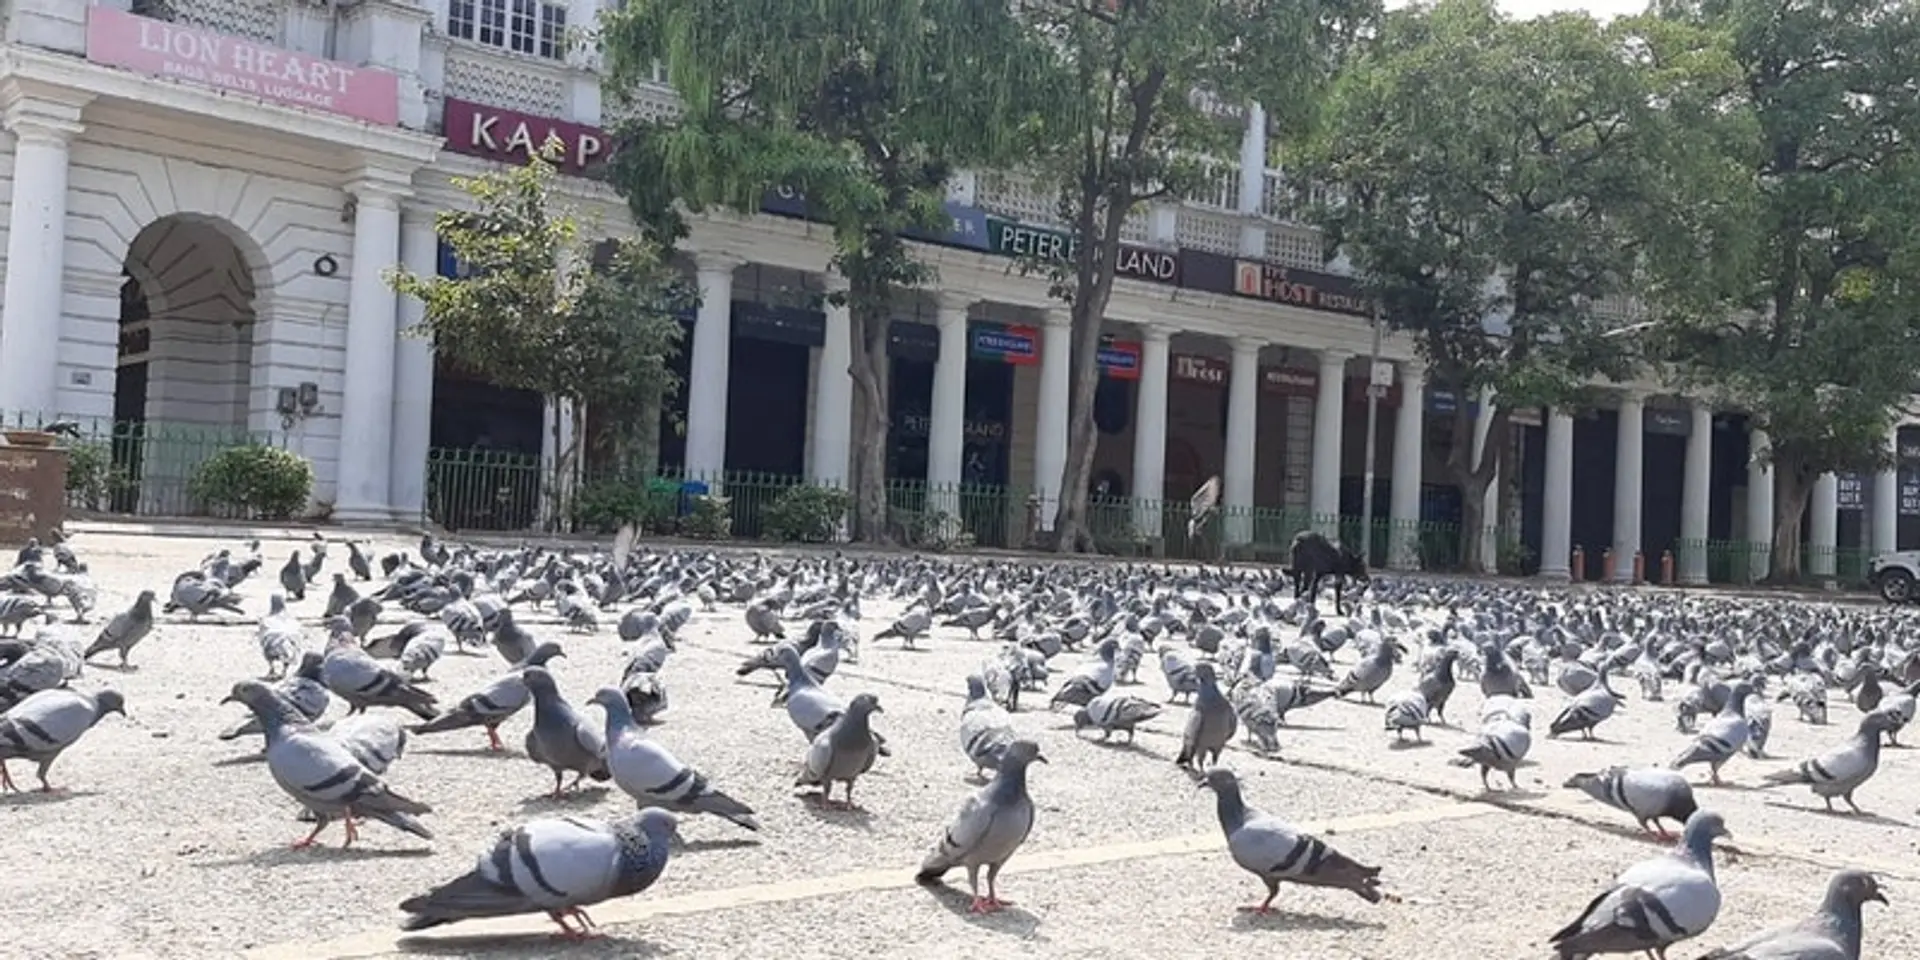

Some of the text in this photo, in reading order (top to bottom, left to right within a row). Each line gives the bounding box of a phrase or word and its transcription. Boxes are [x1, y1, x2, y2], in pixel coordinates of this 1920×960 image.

[139, 21, 354, 93] LION HEART
[264, 84, 334, 107] LUGGAGE
[1001, 226, 1065, 261] PETER
[1068, 234, 1175, 279] ELAND
[1264, 279, 1316, 304] HOST
